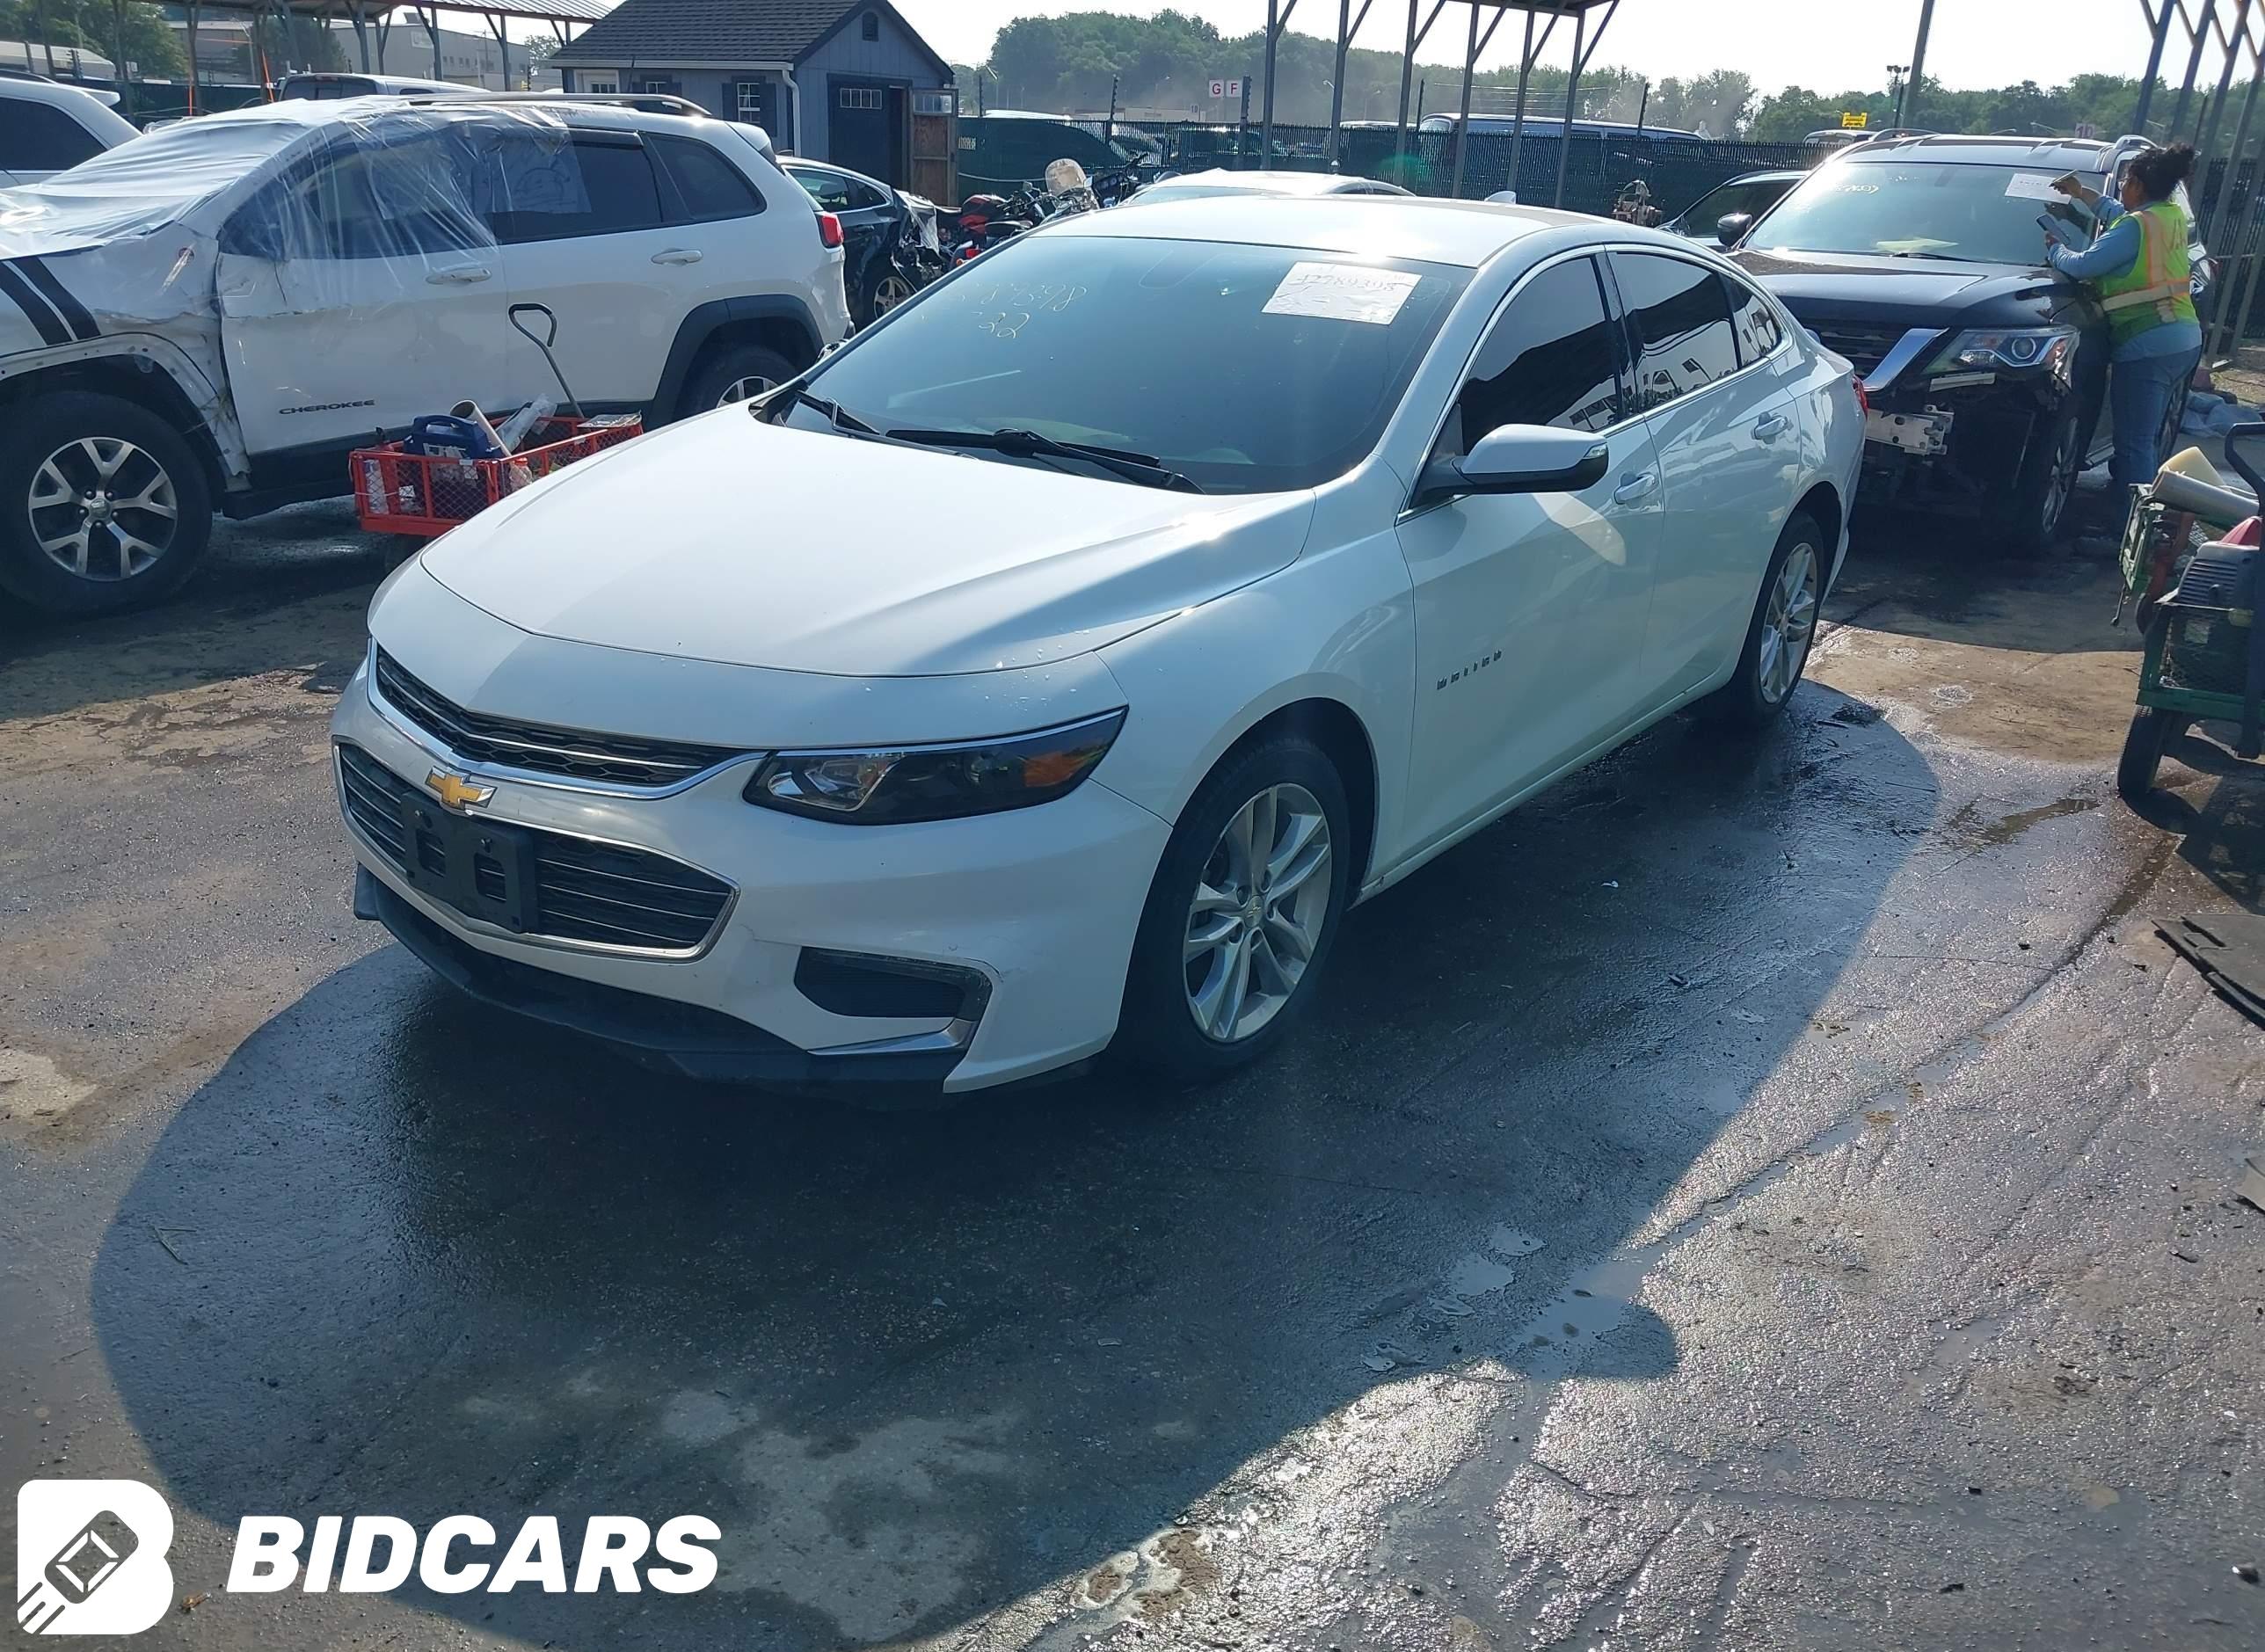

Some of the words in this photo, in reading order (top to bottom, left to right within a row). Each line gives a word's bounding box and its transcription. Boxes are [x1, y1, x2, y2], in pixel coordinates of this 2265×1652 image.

[1213, 83, 1221, 95] G
[1230, 83, 1238, 94] F
[279, 399, 375, 415] CHEROKEE
